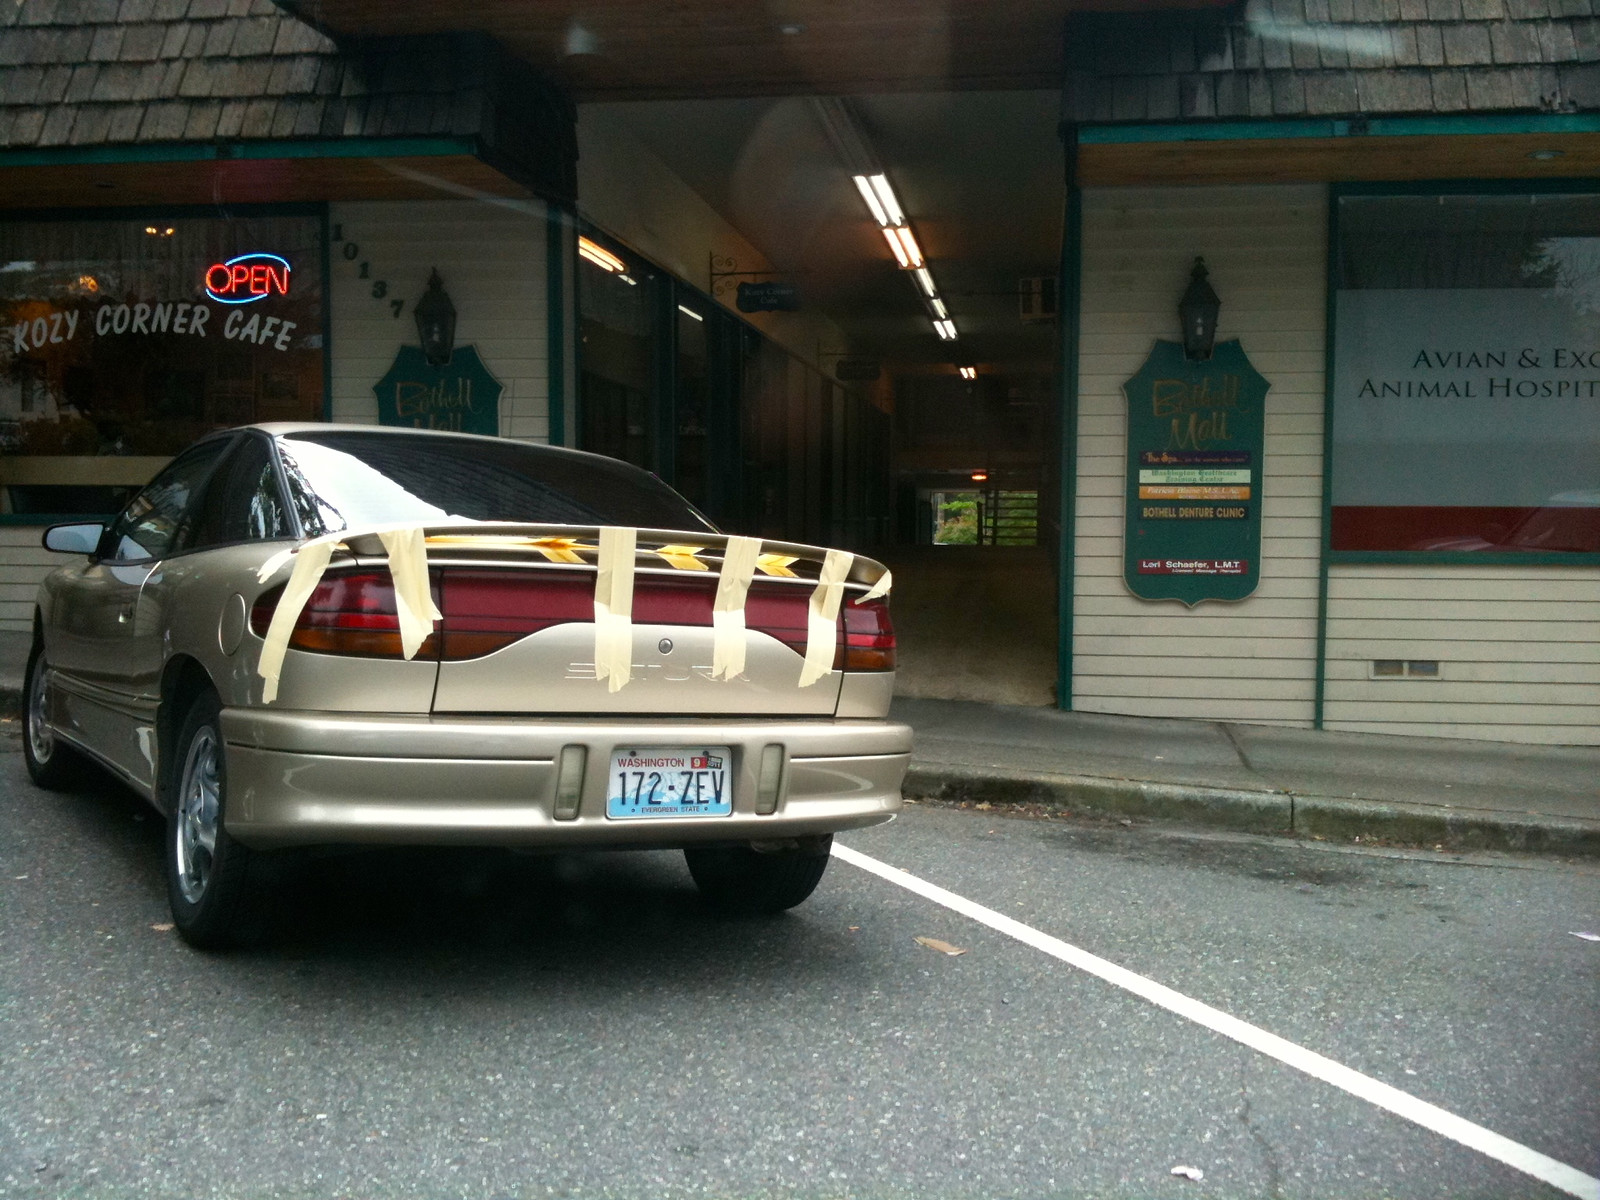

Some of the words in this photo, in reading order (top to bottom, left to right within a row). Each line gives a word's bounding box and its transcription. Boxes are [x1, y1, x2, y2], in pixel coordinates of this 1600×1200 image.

[205, 263, 290, 295] OPEN
[334, 223, 404, 318] 10137
[14, 310, 79, 353] KOZY
[96, 303, 210, 337] CORNER
[224, 309, 297, 351] CAFE
[1413, 349, 1506, 369] AVIAN
[1517, 348, 1540, 369] &
[1358, 378, 1477, 398] ANIMAL
[1164, 411, 1232, 450] Mall
[1143, 507, 1177, 518] BOTHELL
[1178, 507, 1214, 518] DENTURE
[1216, 507, 1245, 518] CLINIC
[1142, 560, 1161, 568] Lori
[1165, 560, 1210, 569] Schaefer,
[617, 757, 685, 768] WASHINGTON
[618, 771, 725, 806] 172-ZEV
